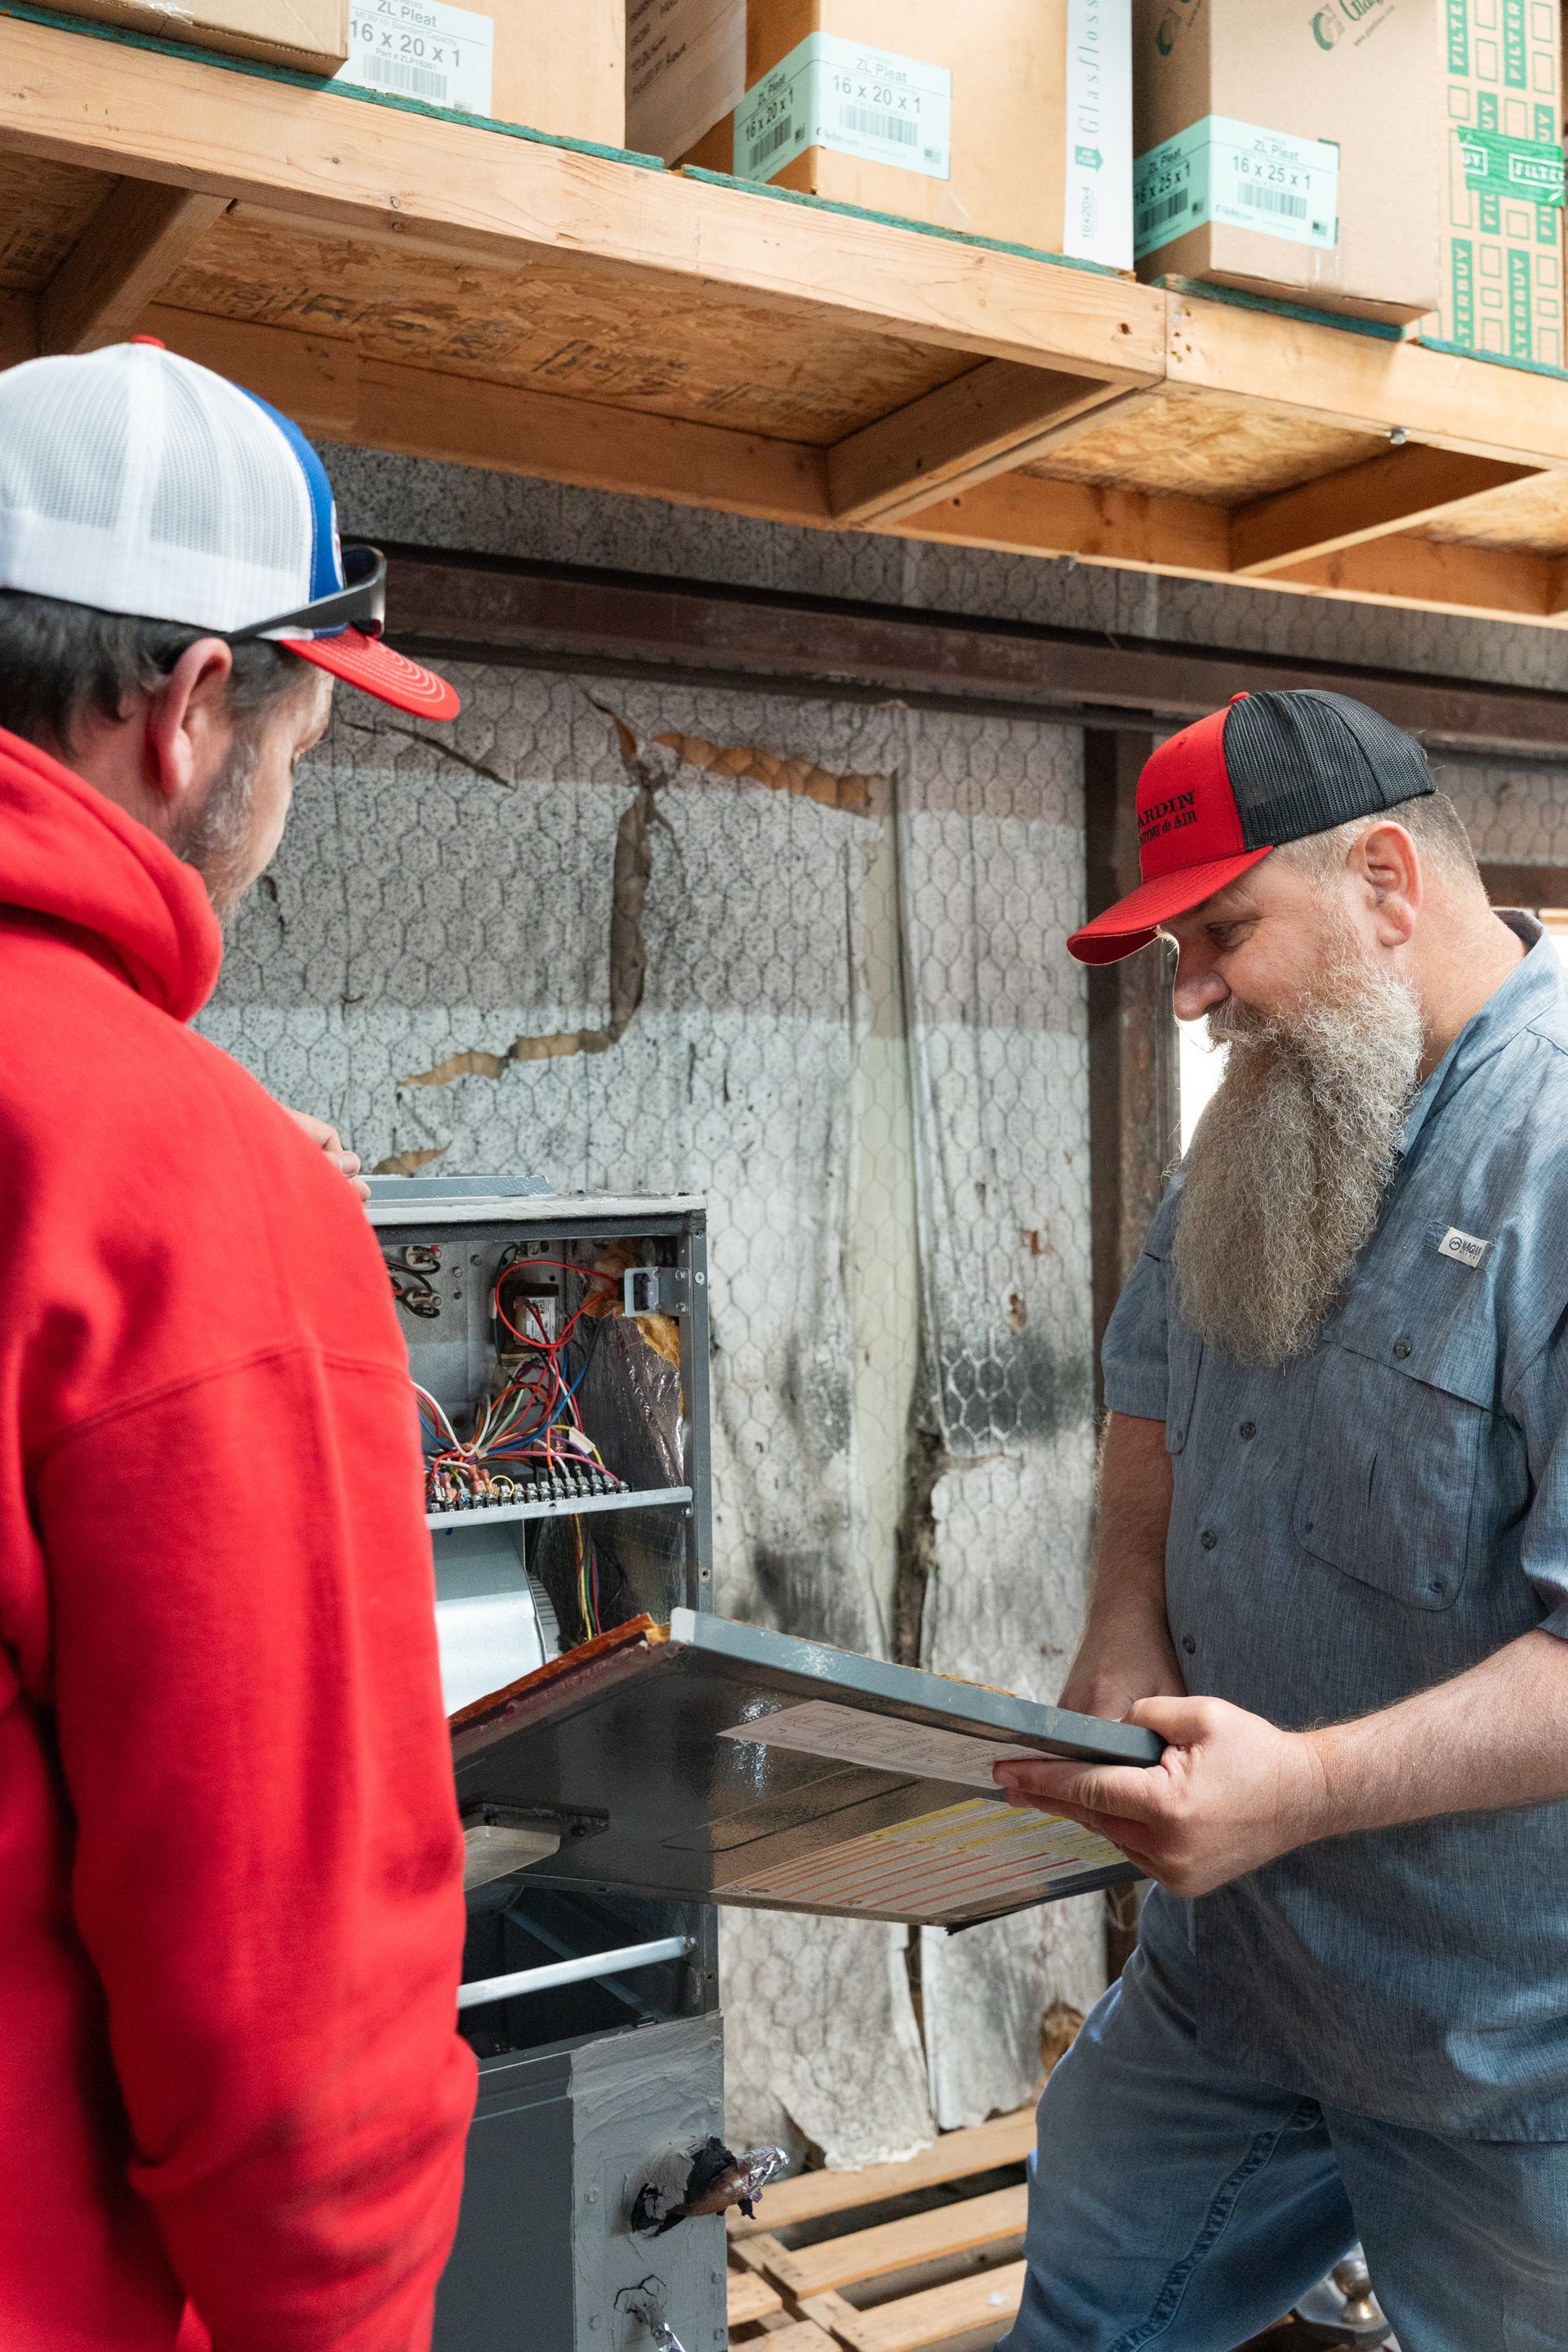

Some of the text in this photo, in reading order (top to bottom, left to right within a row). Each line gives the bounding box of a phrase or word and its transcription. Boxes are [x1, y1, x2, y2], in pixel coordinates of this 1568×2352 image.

[377, 0, 437, 28] ZL Pleat
[350, 20, 461, 67] 16 x 20 x 1
[1450, 0, 1464, 67] FILTE
[376, 47, 392, 59] Part
[856, 58, 871, 74] ZL
[875, 63, 907, 83] Pleat
[789, 86, 795, 105] 1
[833, 74, 852, 95] 16
[858, 84, 866, 99] x
[873, 86, 893, 105] 20
[898, 96, 907, 110] x
[914, 96, 921, 114] 1
[1254, 139, 1268, 154] ZL
[1271, 145, 1299, 162] Pleat
[1158, 172, 1173, 194] 25
[1186, 159, 1191, 179] 1
[1232, 154, 1250, 174] 16
[1254, 163, 1263, 178] x
[1268, 164, 1285, 184] 25
[1290, 174, 1298, 188] x
[1305, 174, 1312, 190] 1
[1174, 809, 1198, 830] AIR
